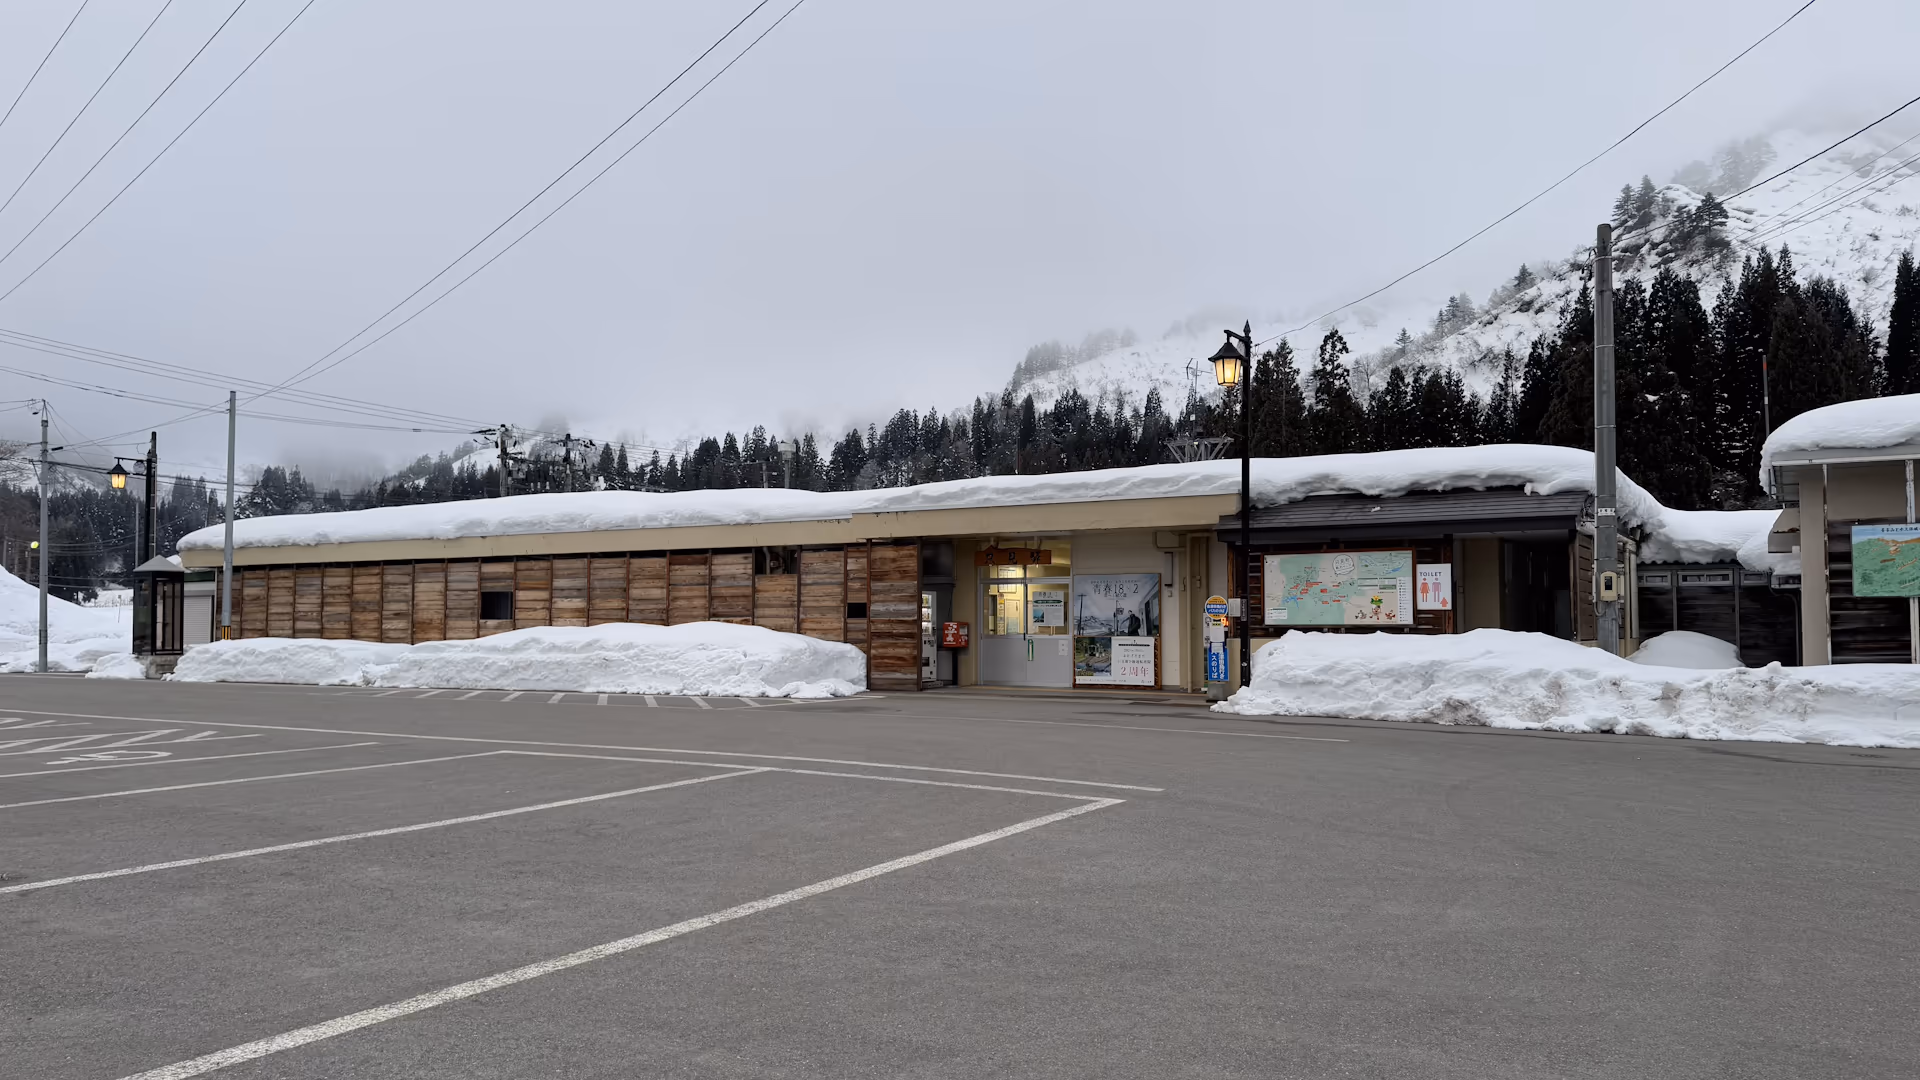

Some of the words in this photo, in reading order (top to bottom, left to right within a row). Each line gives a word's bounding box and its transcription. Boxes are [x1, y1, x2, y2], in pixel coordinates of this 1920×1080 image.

[985, 551, 1041, 565] 只見駅
[1121, 666, 1149, 677] 2周年
